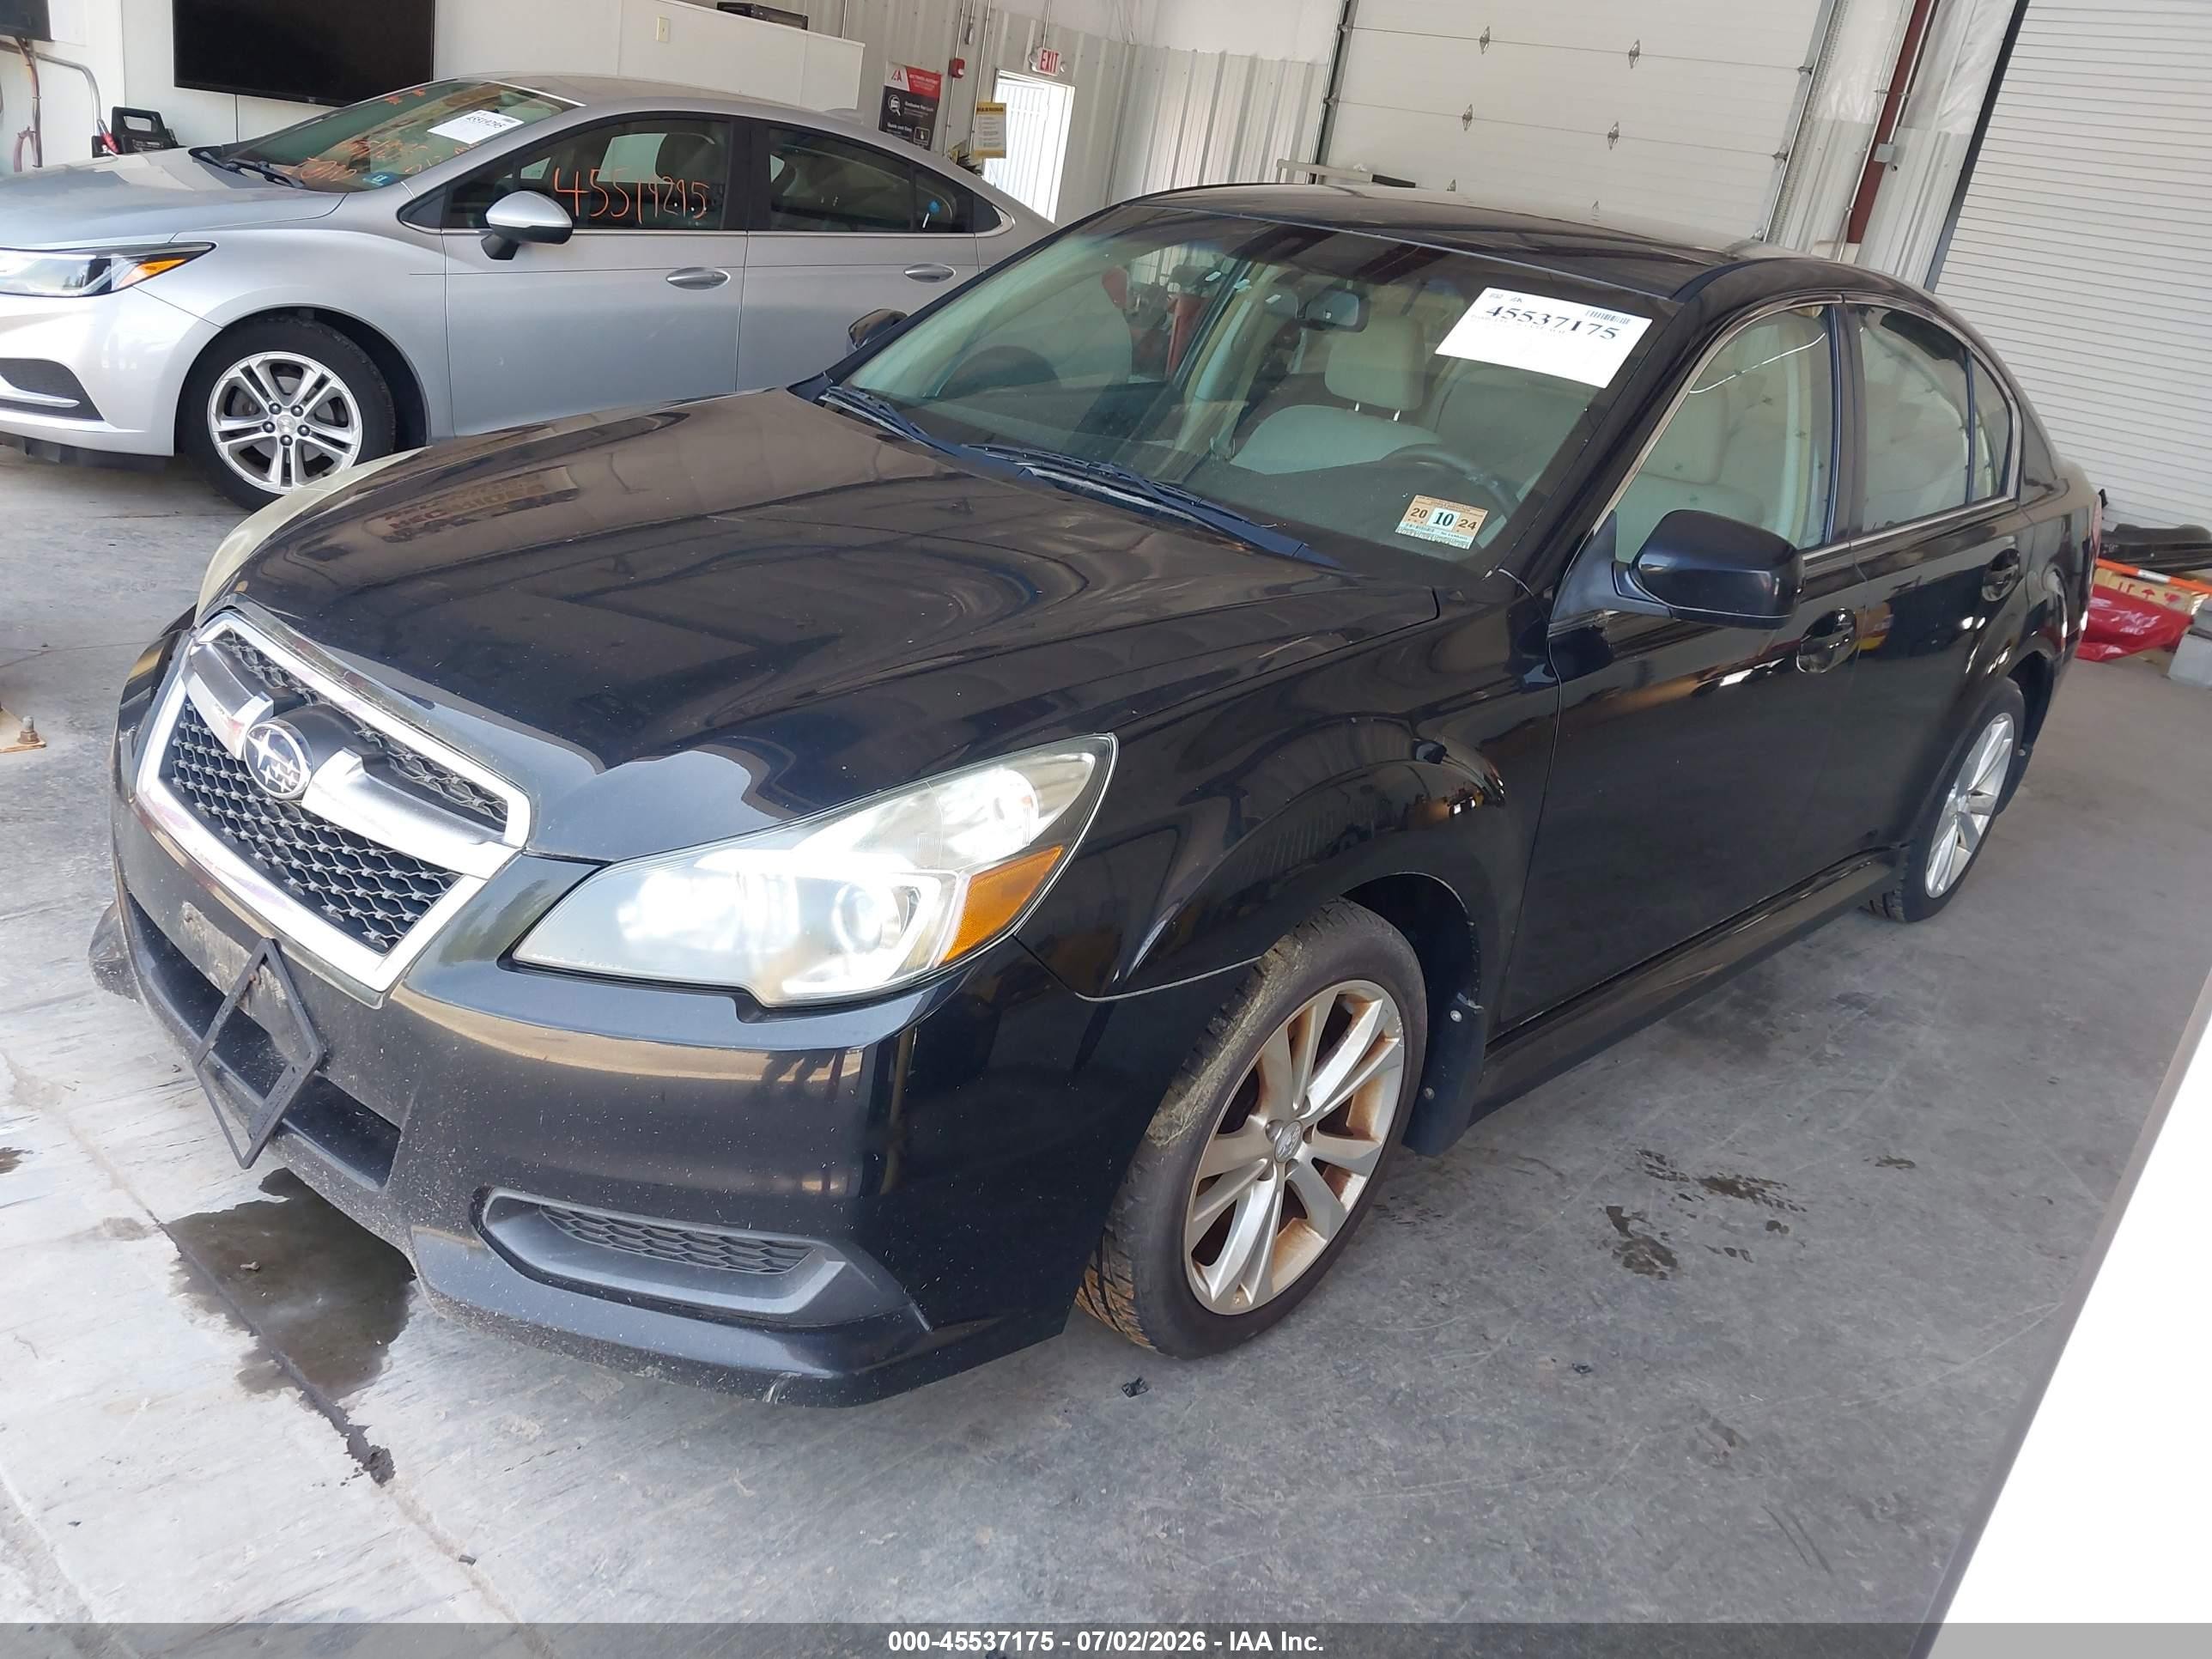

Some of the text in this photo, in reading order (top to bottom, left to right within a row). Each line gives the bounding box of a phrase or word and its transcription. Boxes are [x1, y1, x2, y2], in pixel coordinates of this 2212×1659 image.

[1040, 49, 1060, 73] EXIT
[554, 167, 710, 225] 45519295
[1485, 305, 1620, 340] 45537175
[1410, 507, 1478, 531] 20 10 24
